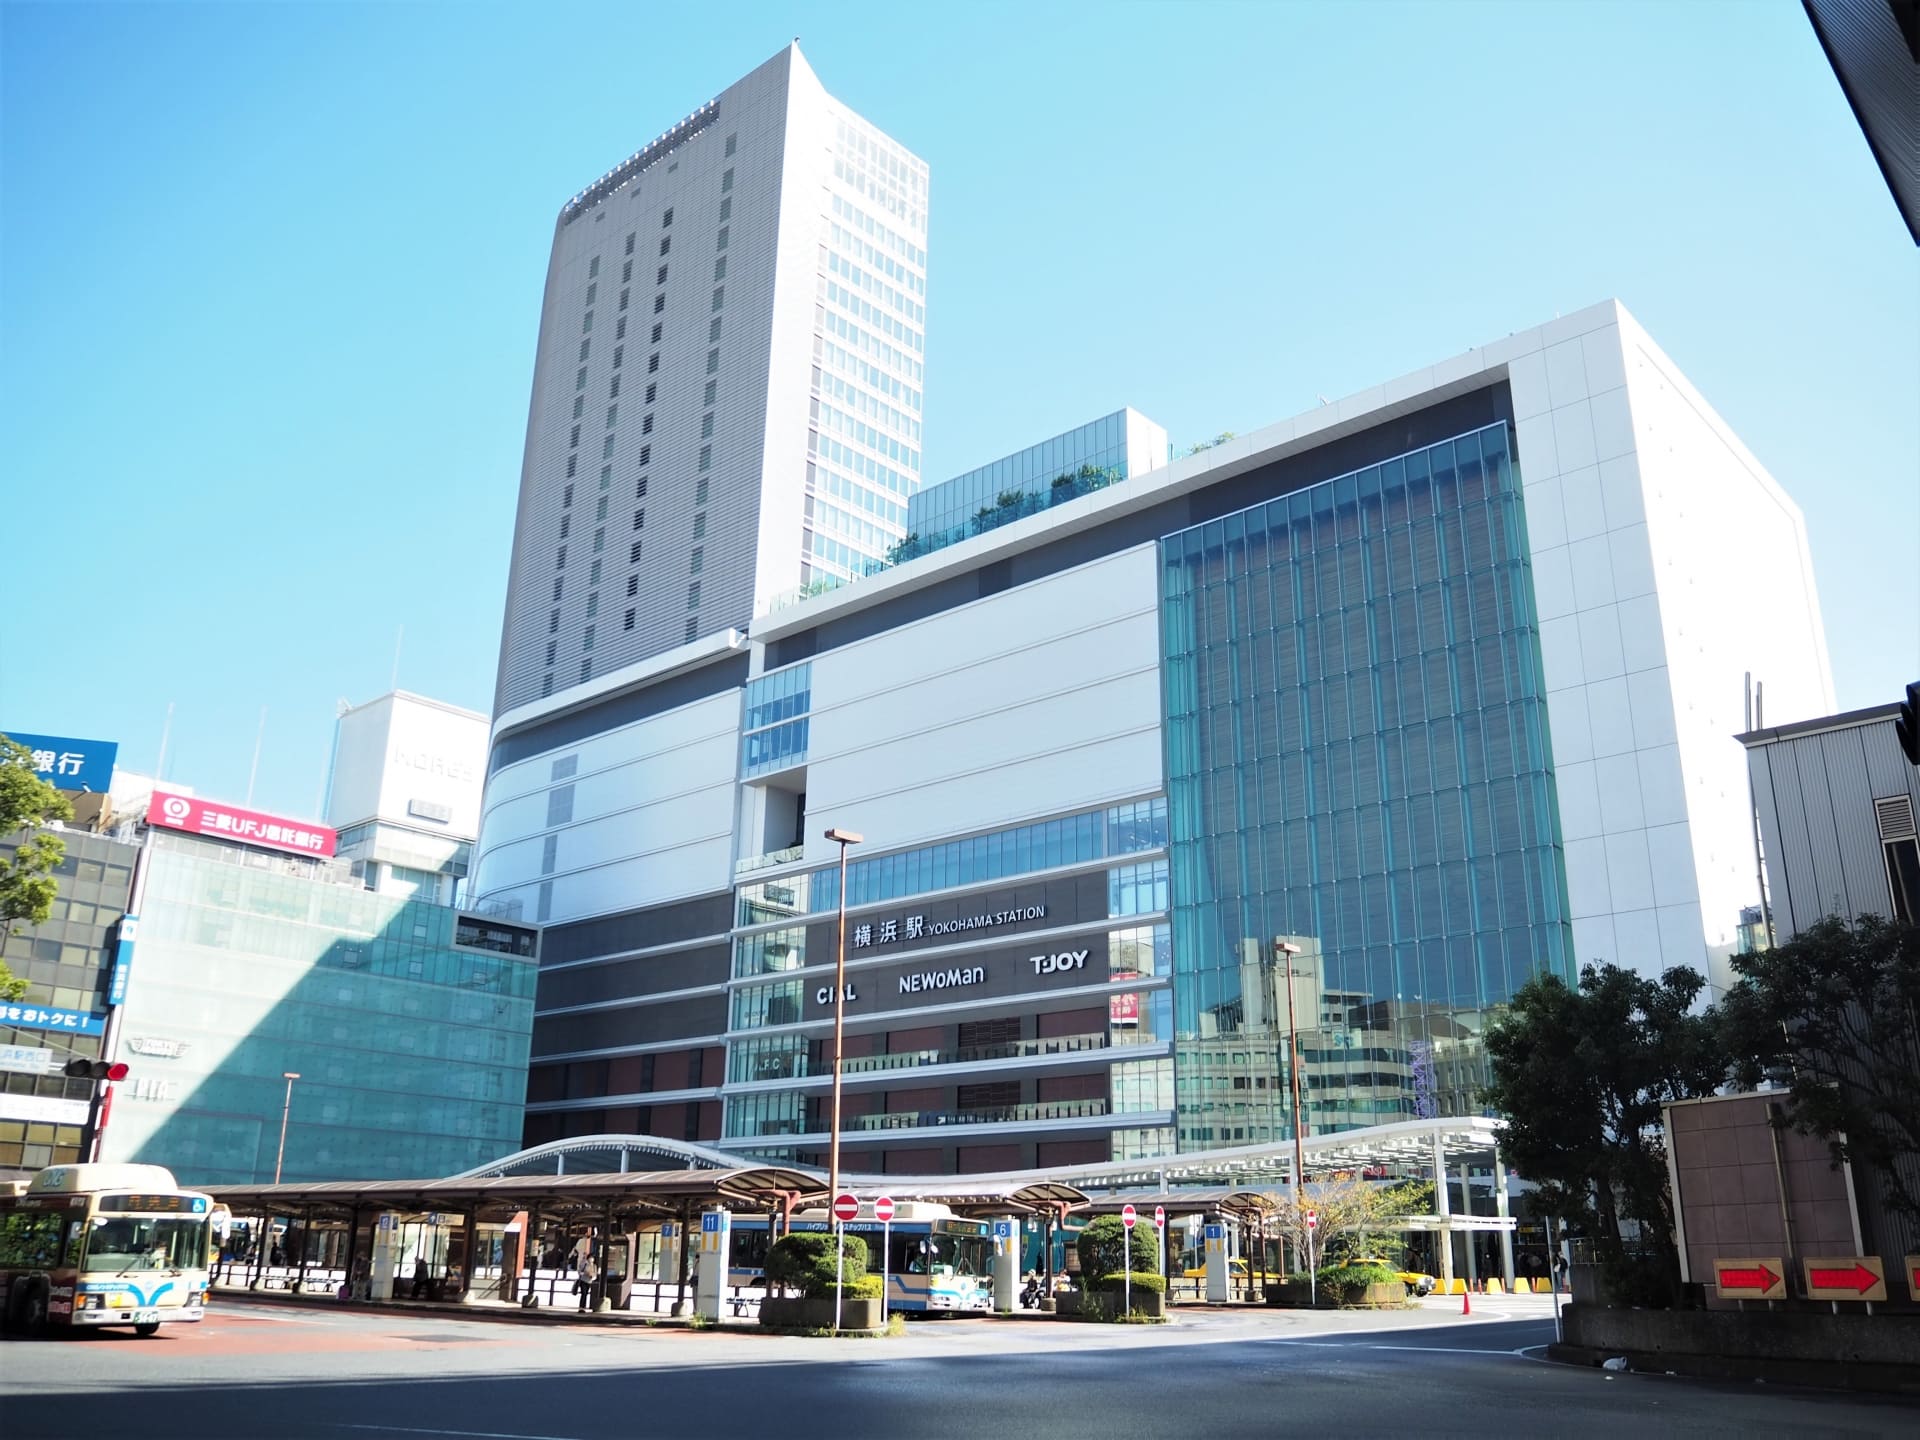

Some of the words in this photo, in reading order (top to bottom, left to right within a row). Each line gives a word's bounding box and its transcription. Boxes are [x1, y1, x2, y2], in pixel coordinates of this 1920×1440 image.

[0, 745, 85, 776] 銀行
[200, 810, 324, 850] 三菱UFJ信託銀行
[854, 915, 924, 948] 横浜駅
[928, 914, 993, 936] YOKOHAMA
[996, 905, 1045, 925] STATION
[899, 966, 984, 994] NEWoMan
[706, 1216, 715, 1230] 11
[1000, 1224, 1007, 1236] 6
